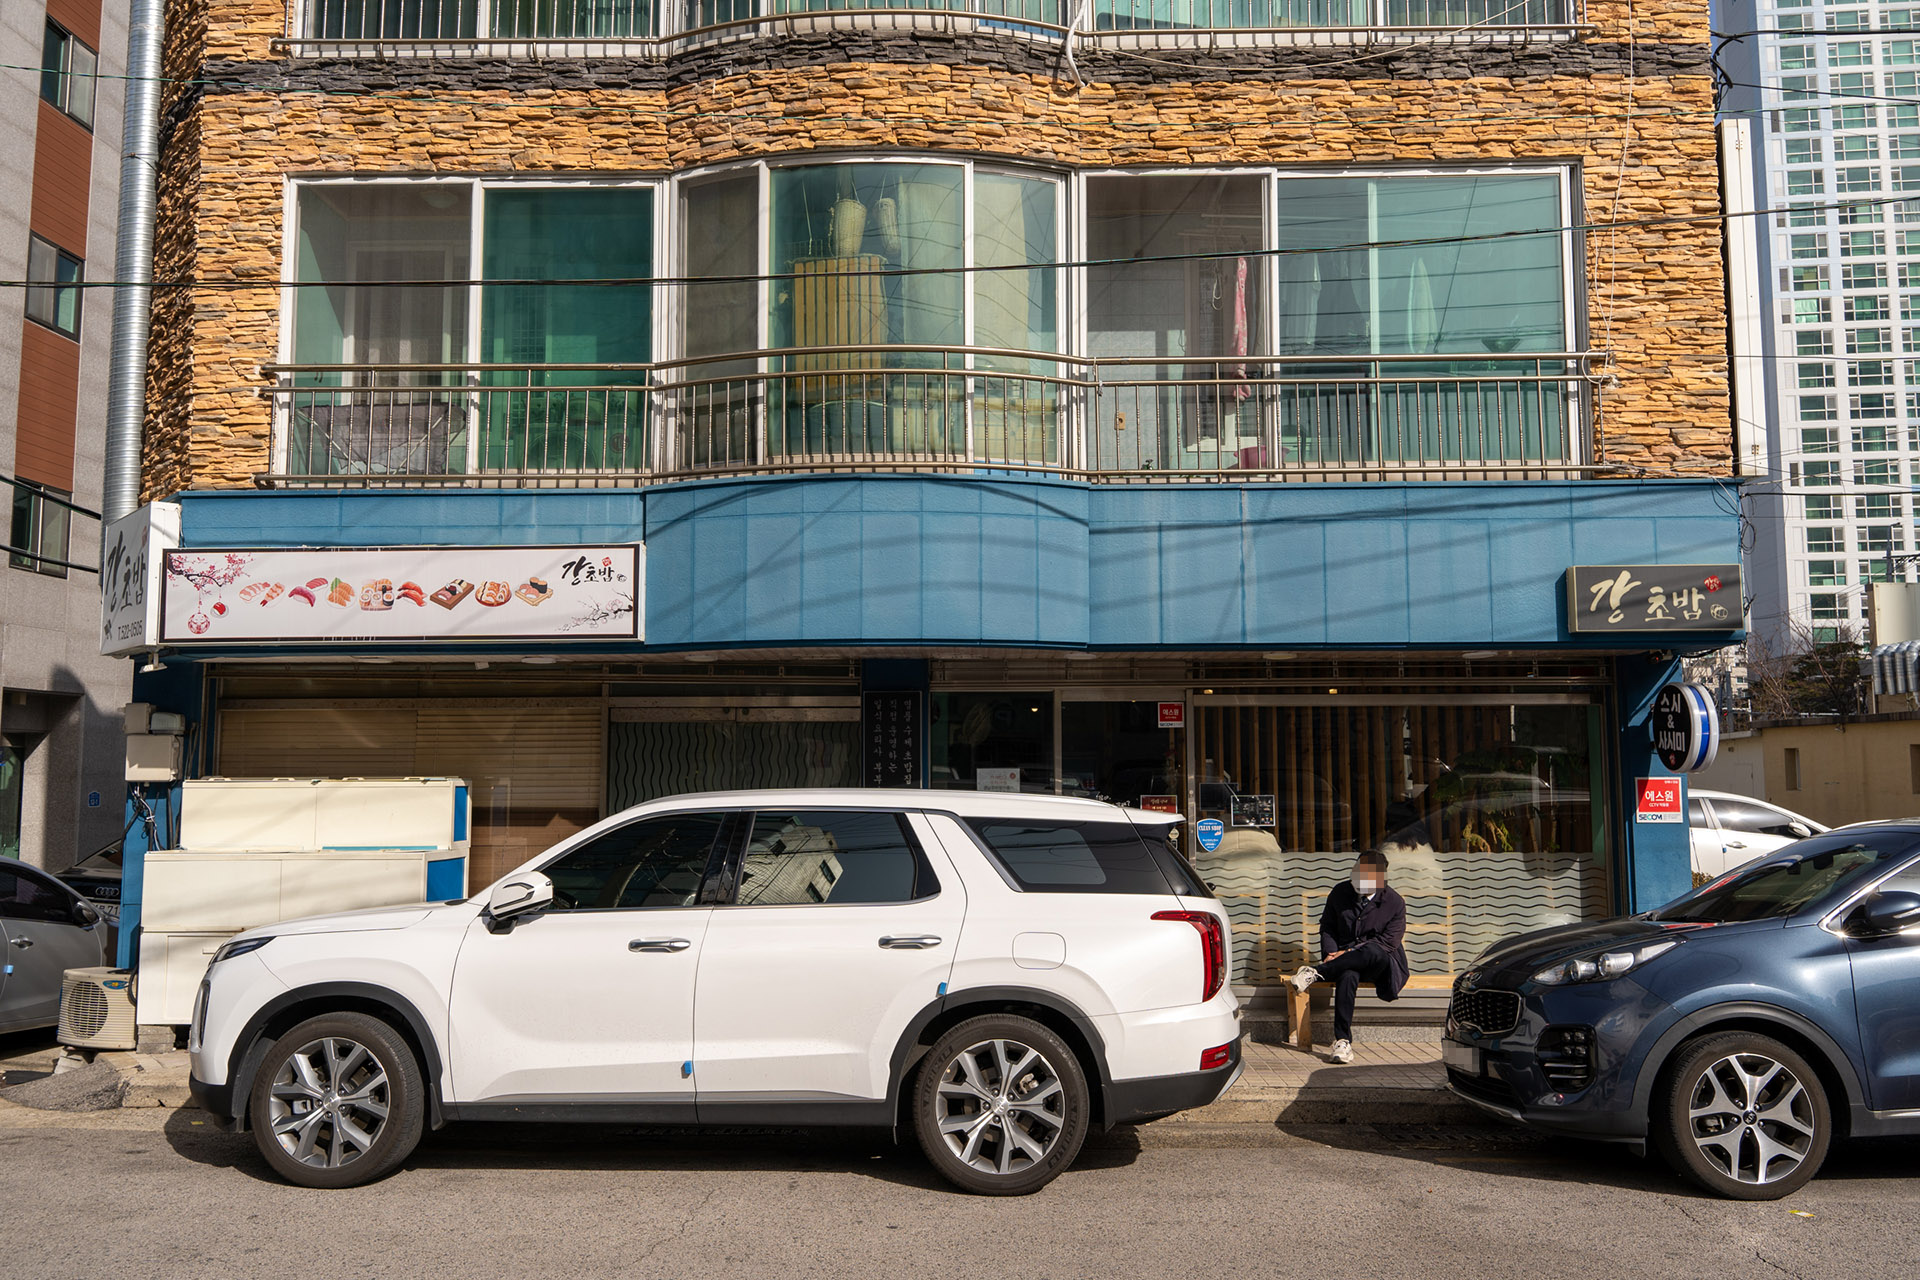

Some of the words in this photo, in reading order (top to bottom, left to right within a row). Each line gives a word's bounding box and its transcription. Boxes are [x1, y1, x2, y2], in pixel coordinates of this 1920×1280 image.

[1660, 692, 1681, 714] 스시
[1667, 714, 1674, 729] &
[1658, 730, 1686, 752] 사시미
[1645, 790, 1674, 802] 에스원
[1638, 813, 1662, 821] SECOM
